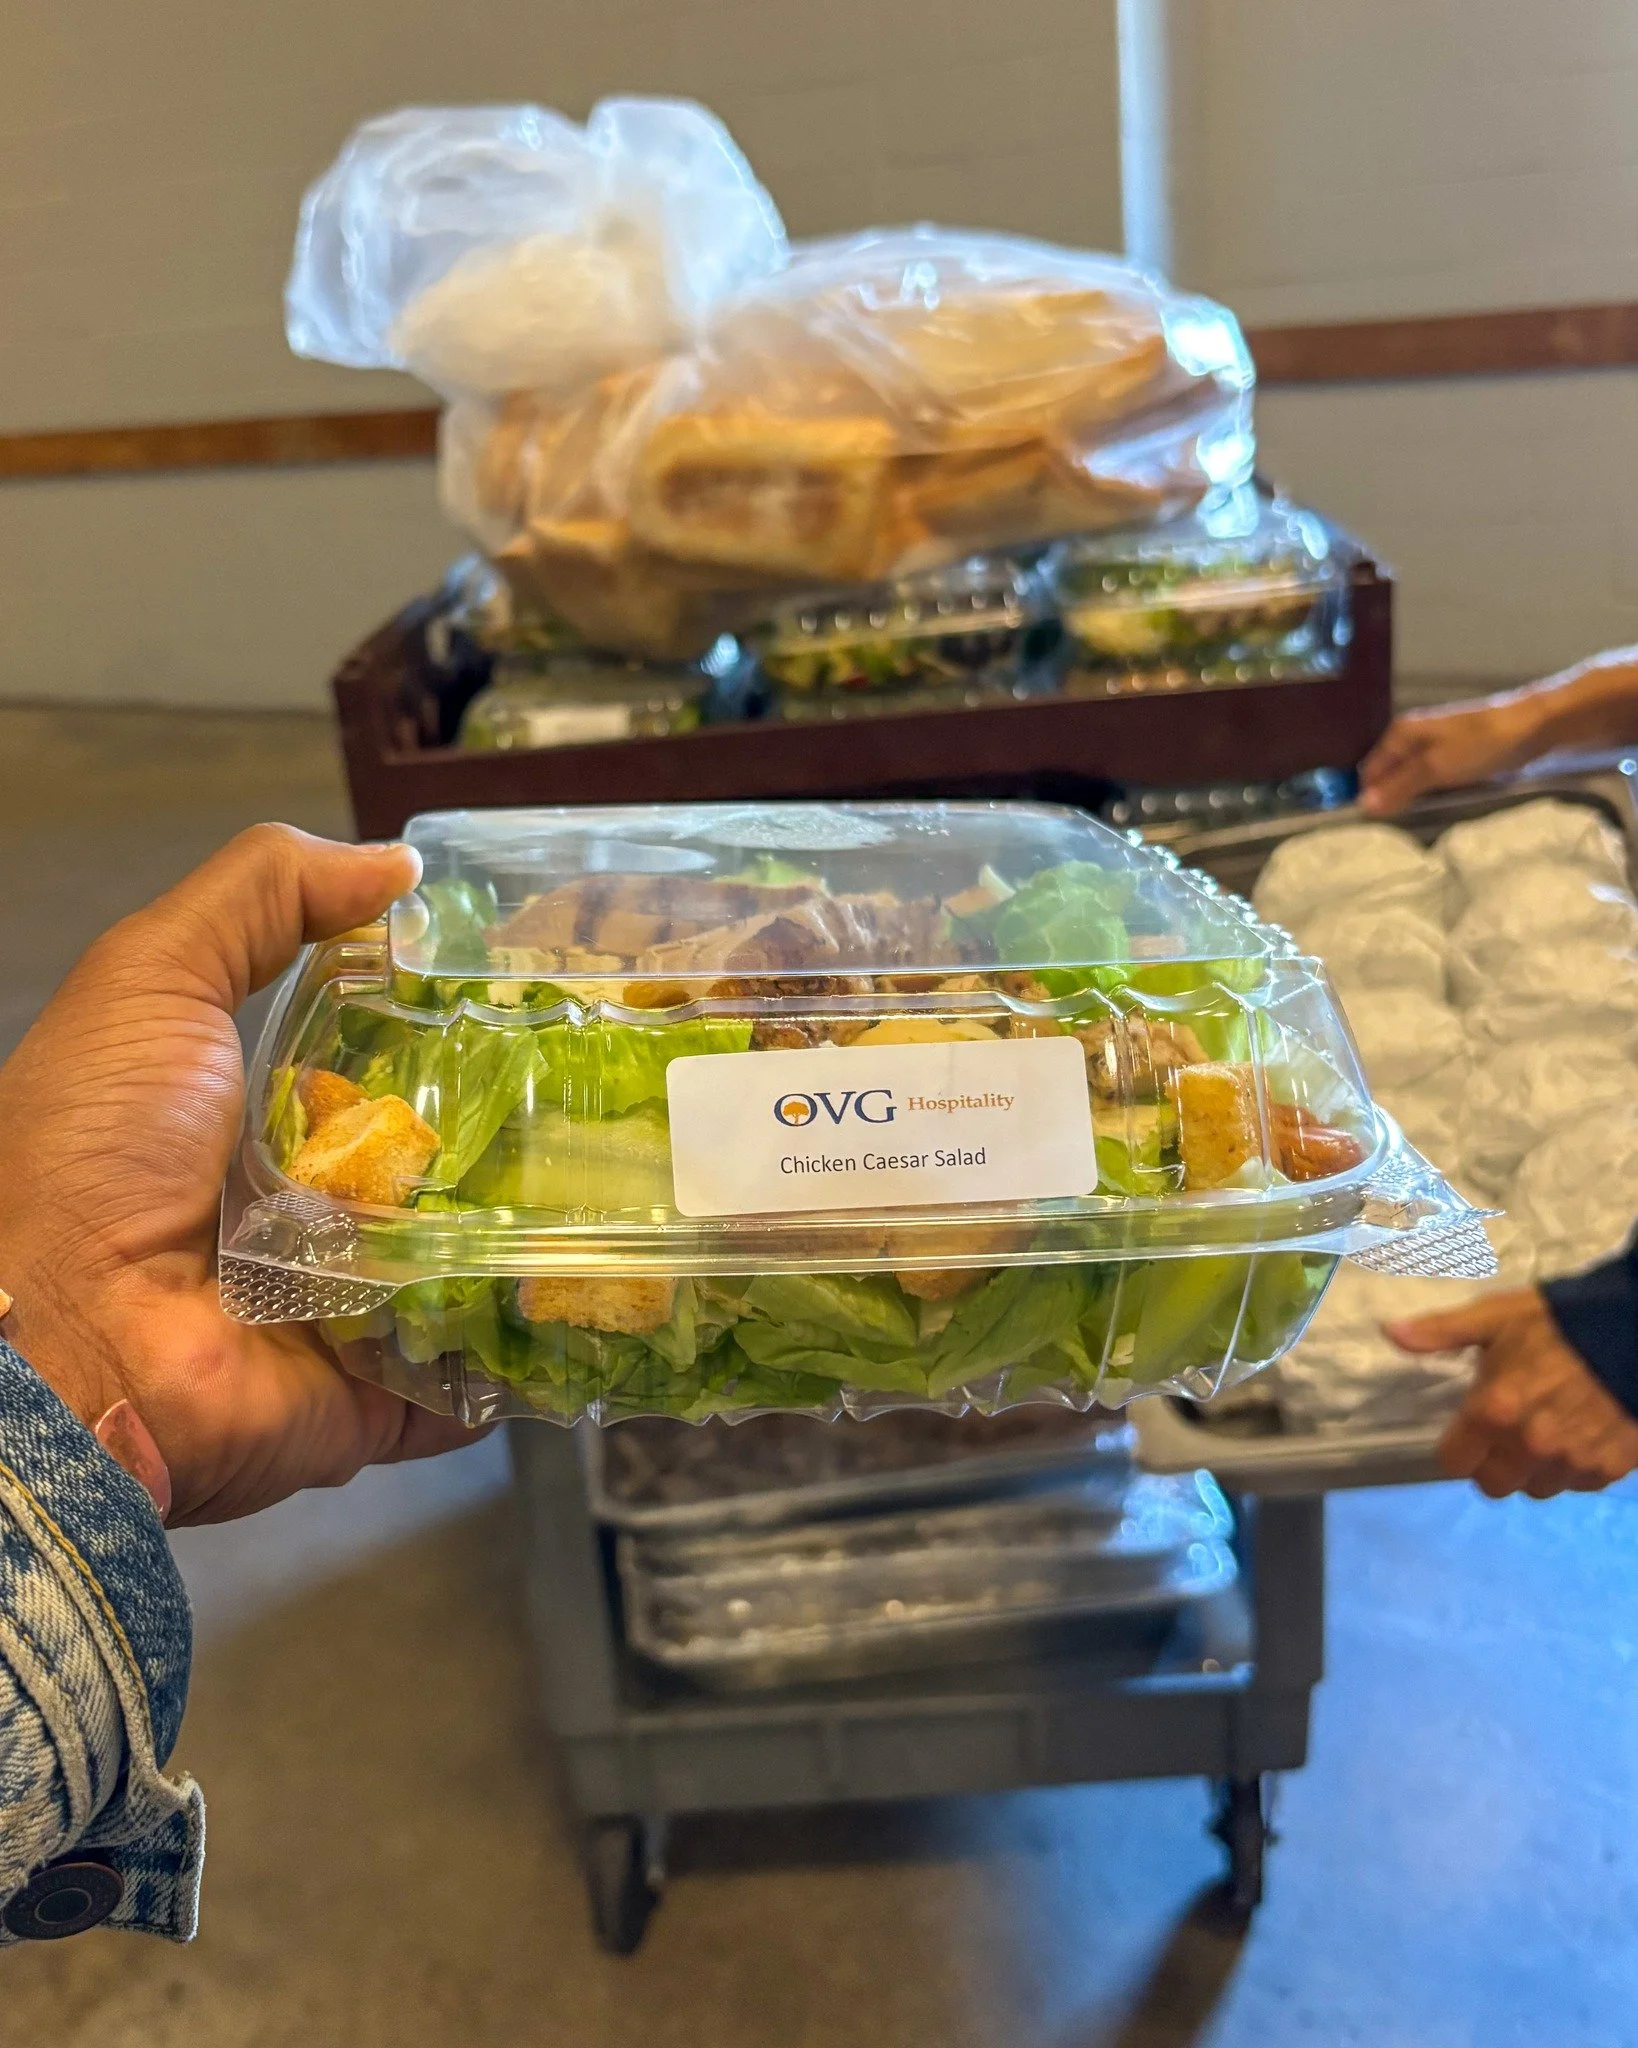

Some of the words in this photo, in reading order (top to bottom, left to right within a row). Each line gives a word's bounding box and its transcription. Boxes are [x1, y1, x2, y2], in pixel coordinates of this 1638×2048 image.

[774, 1089, 897, 1127] OVG
[908, 1093, 1015, 1114] Hospitality
[780, 1154, 856, 1174] Chicken
[863, 1152, 929, 1170] Caesar
[935, 1147, 987, 1167] Salad
